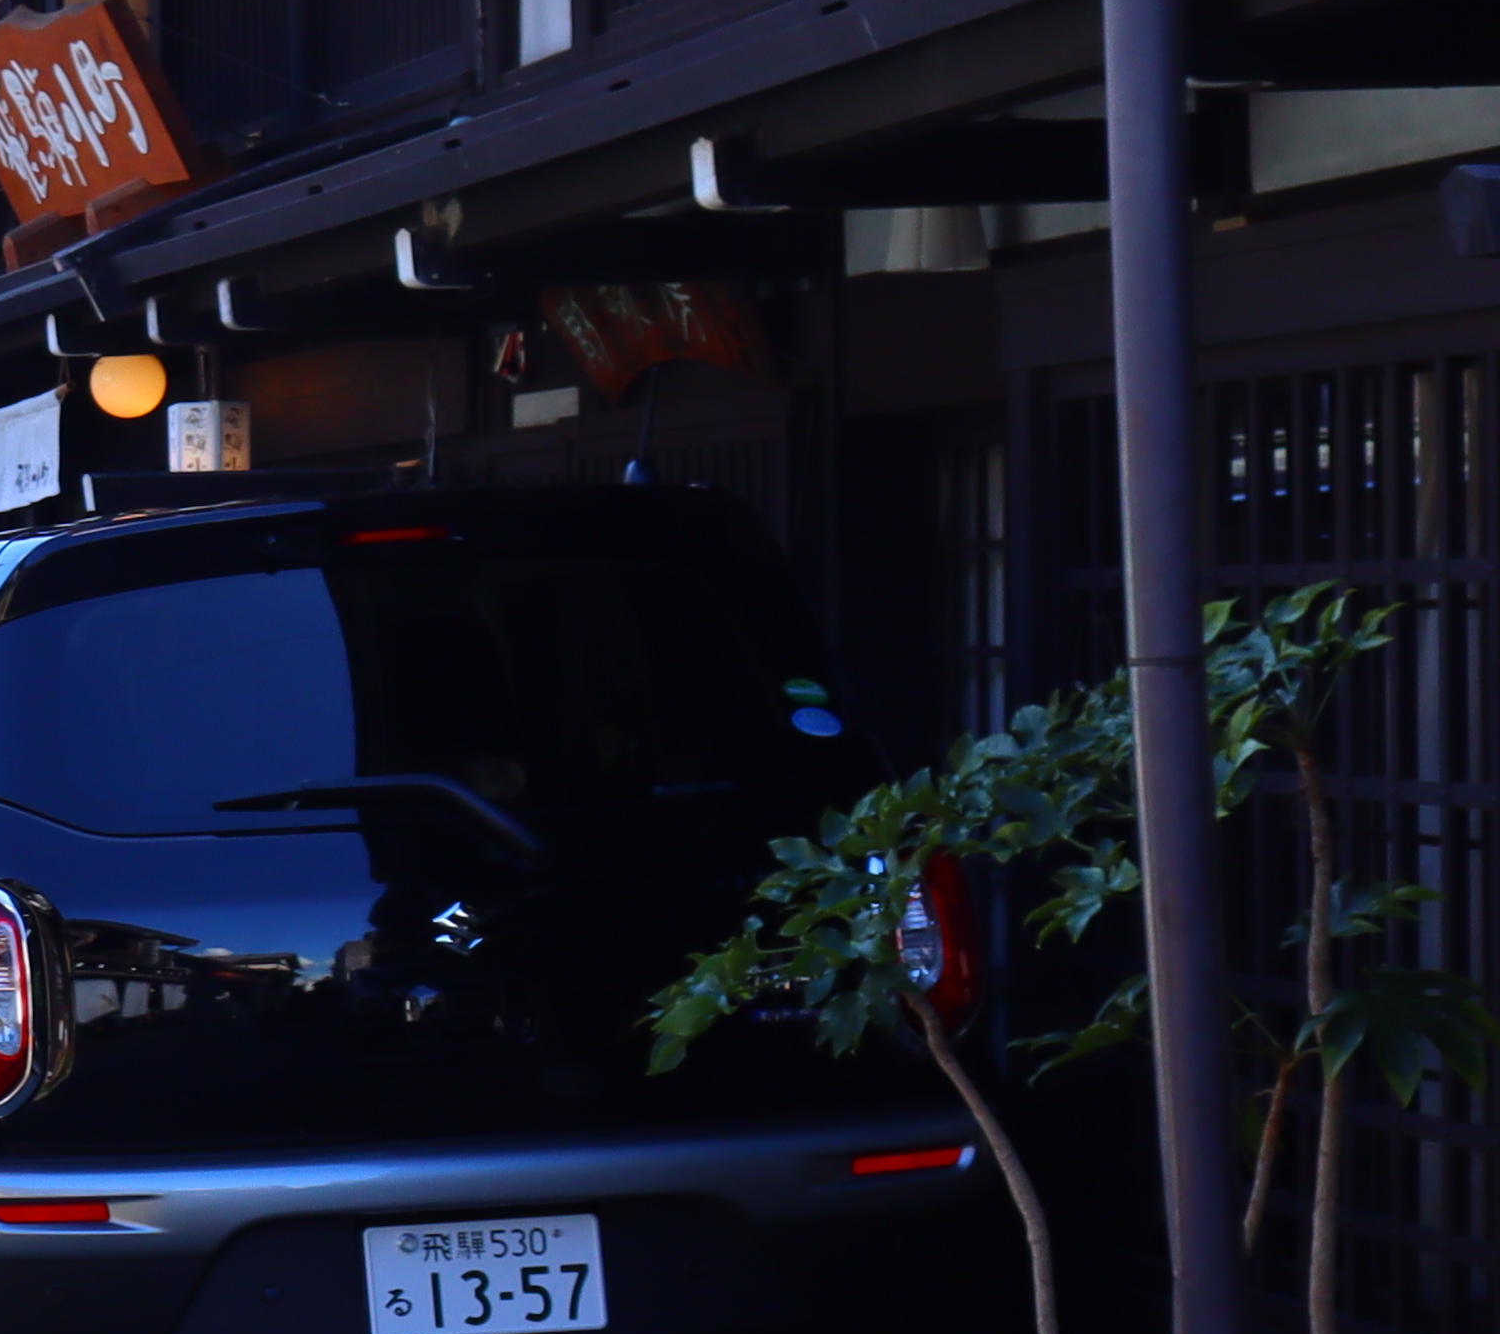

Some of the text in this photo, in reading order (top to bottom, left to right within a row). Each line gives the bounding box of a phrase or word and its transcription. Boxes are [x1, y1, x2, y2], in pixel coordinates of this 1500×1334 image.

[489, 1227, 548, 1259] 530
[384, 1263, 590, 1329] る 13-57
